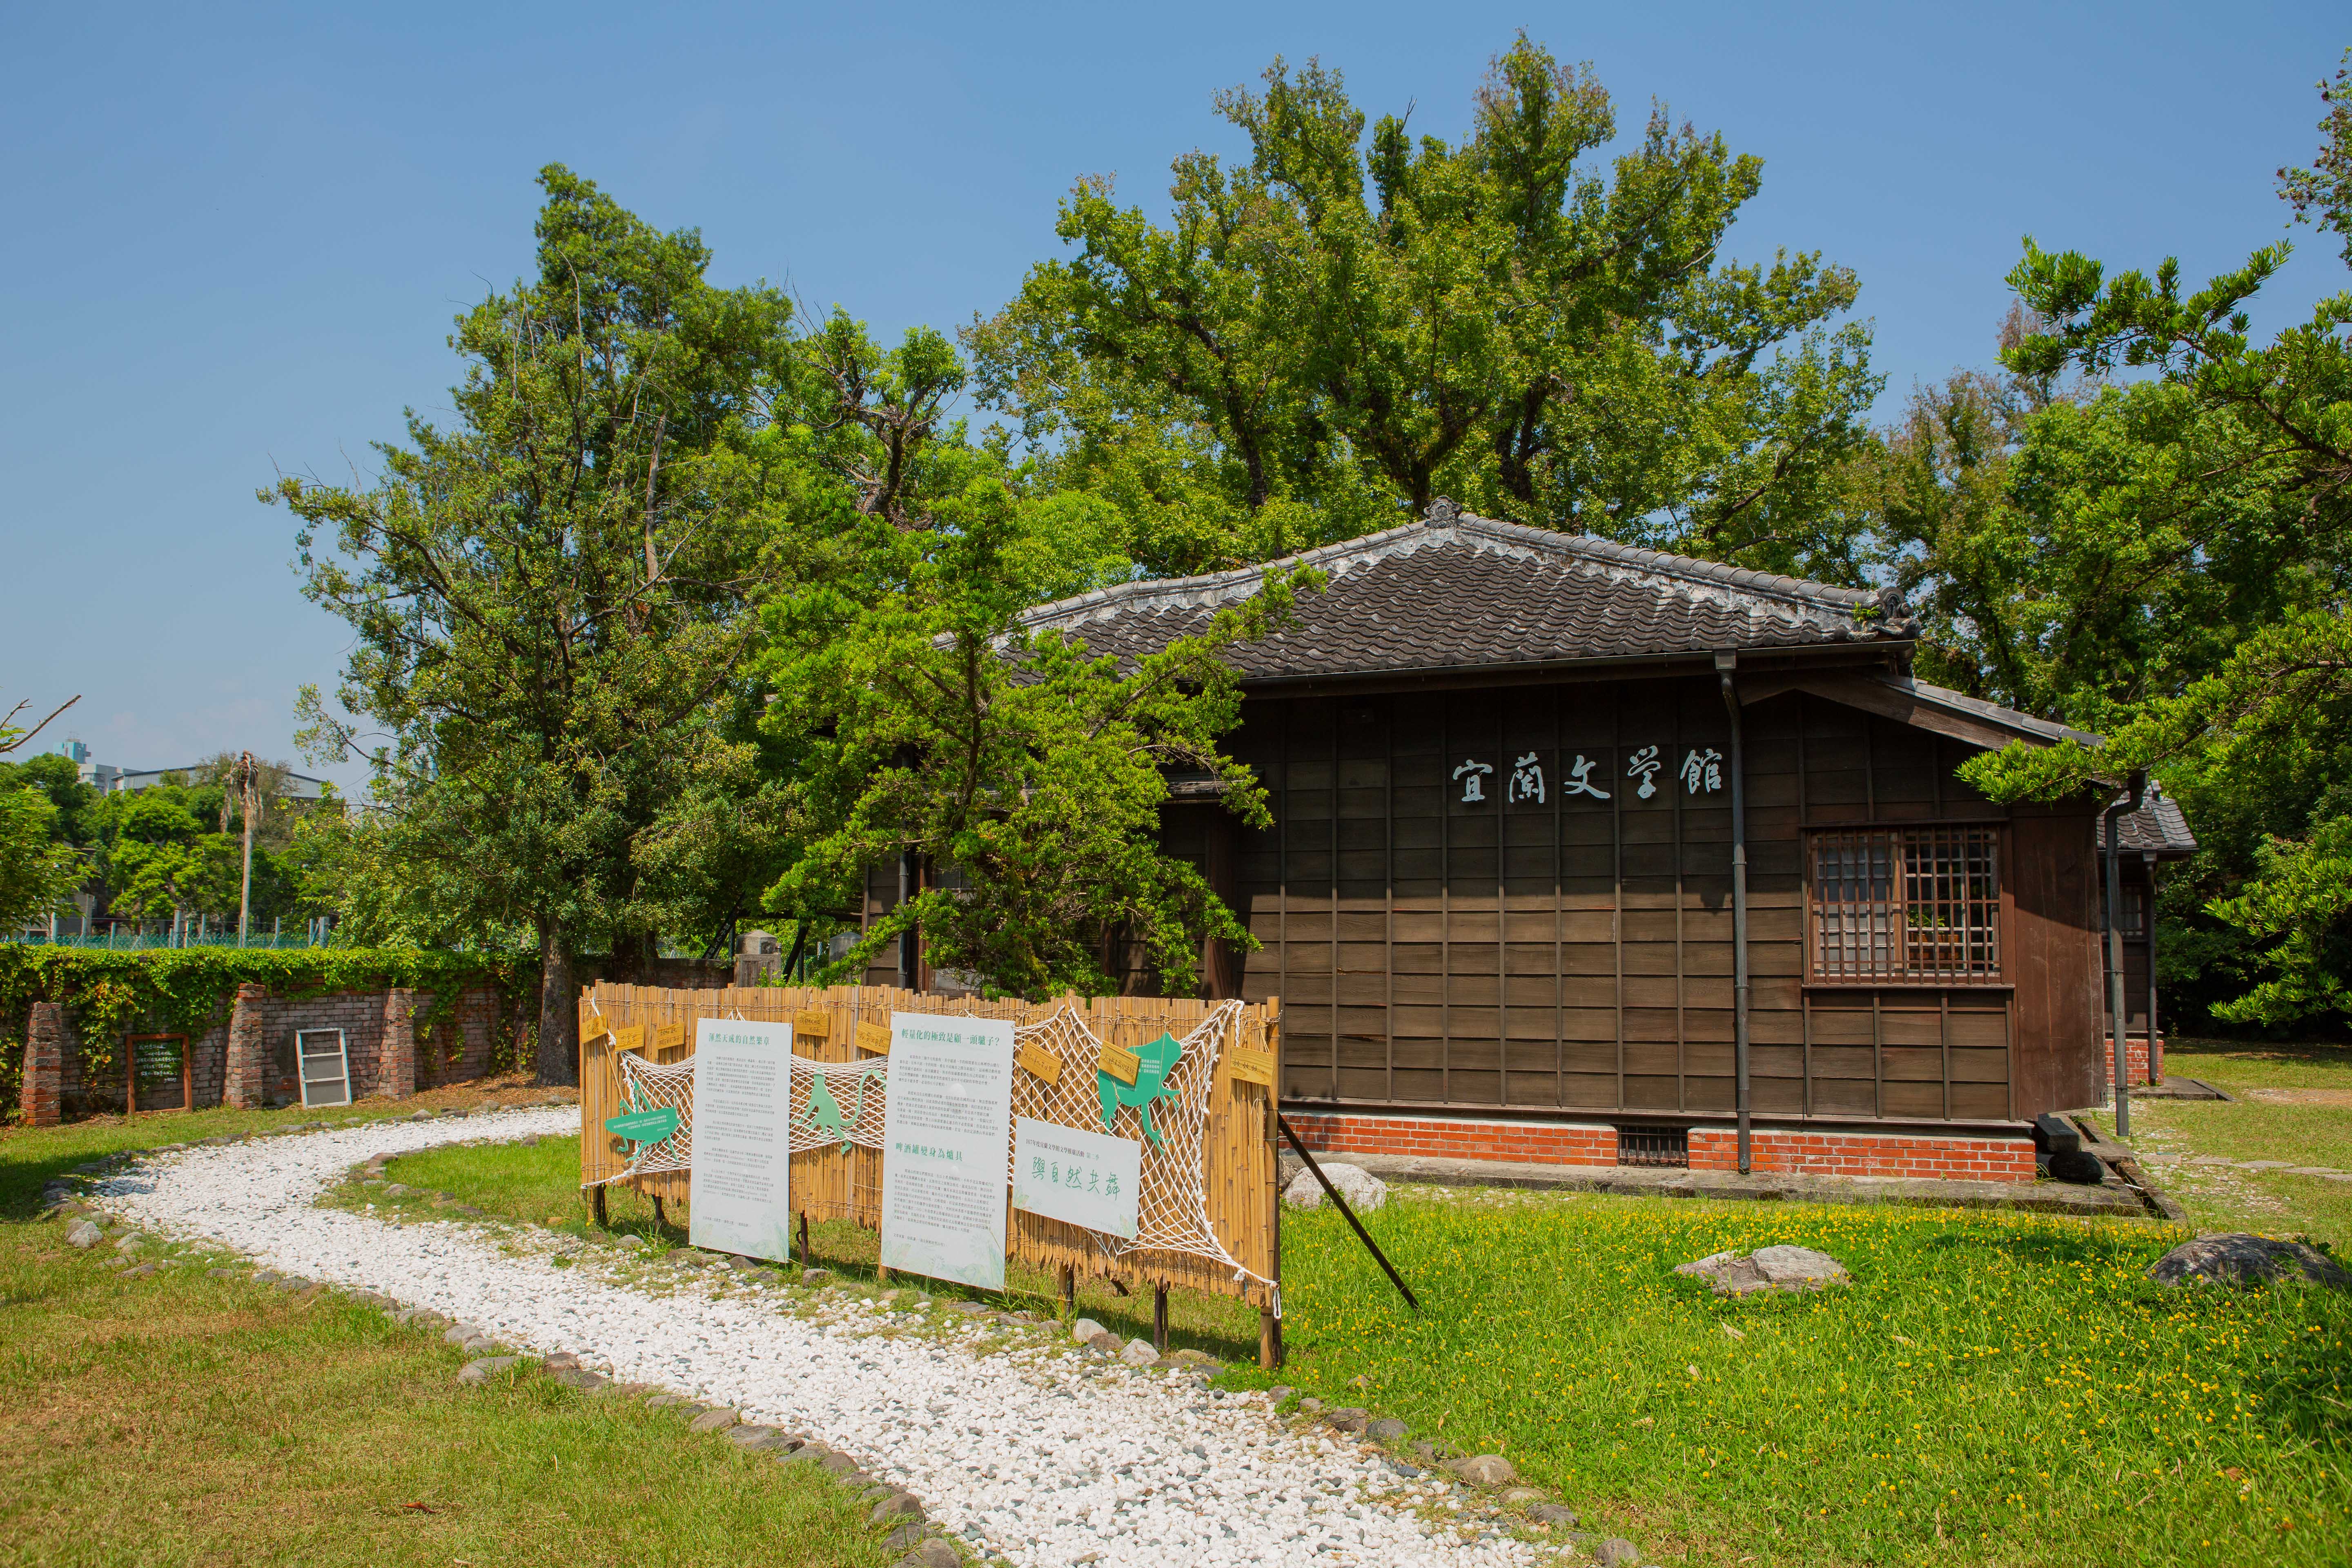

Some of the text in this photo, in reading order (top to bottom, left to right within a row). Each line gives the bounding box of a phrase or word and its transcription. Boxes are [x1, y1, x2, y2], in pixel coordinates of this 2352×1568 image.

[708, 1033, 770, 1046] 渾然天成的自然樂章
[895, 1142, 963, 1162] 啤酒罐變身為爐具
[1026, 1138, 1085, 1158] 107年度宜蘭文學館文學推廣活動
[1032, 1156, 1120, 1201] 與自然共舞
